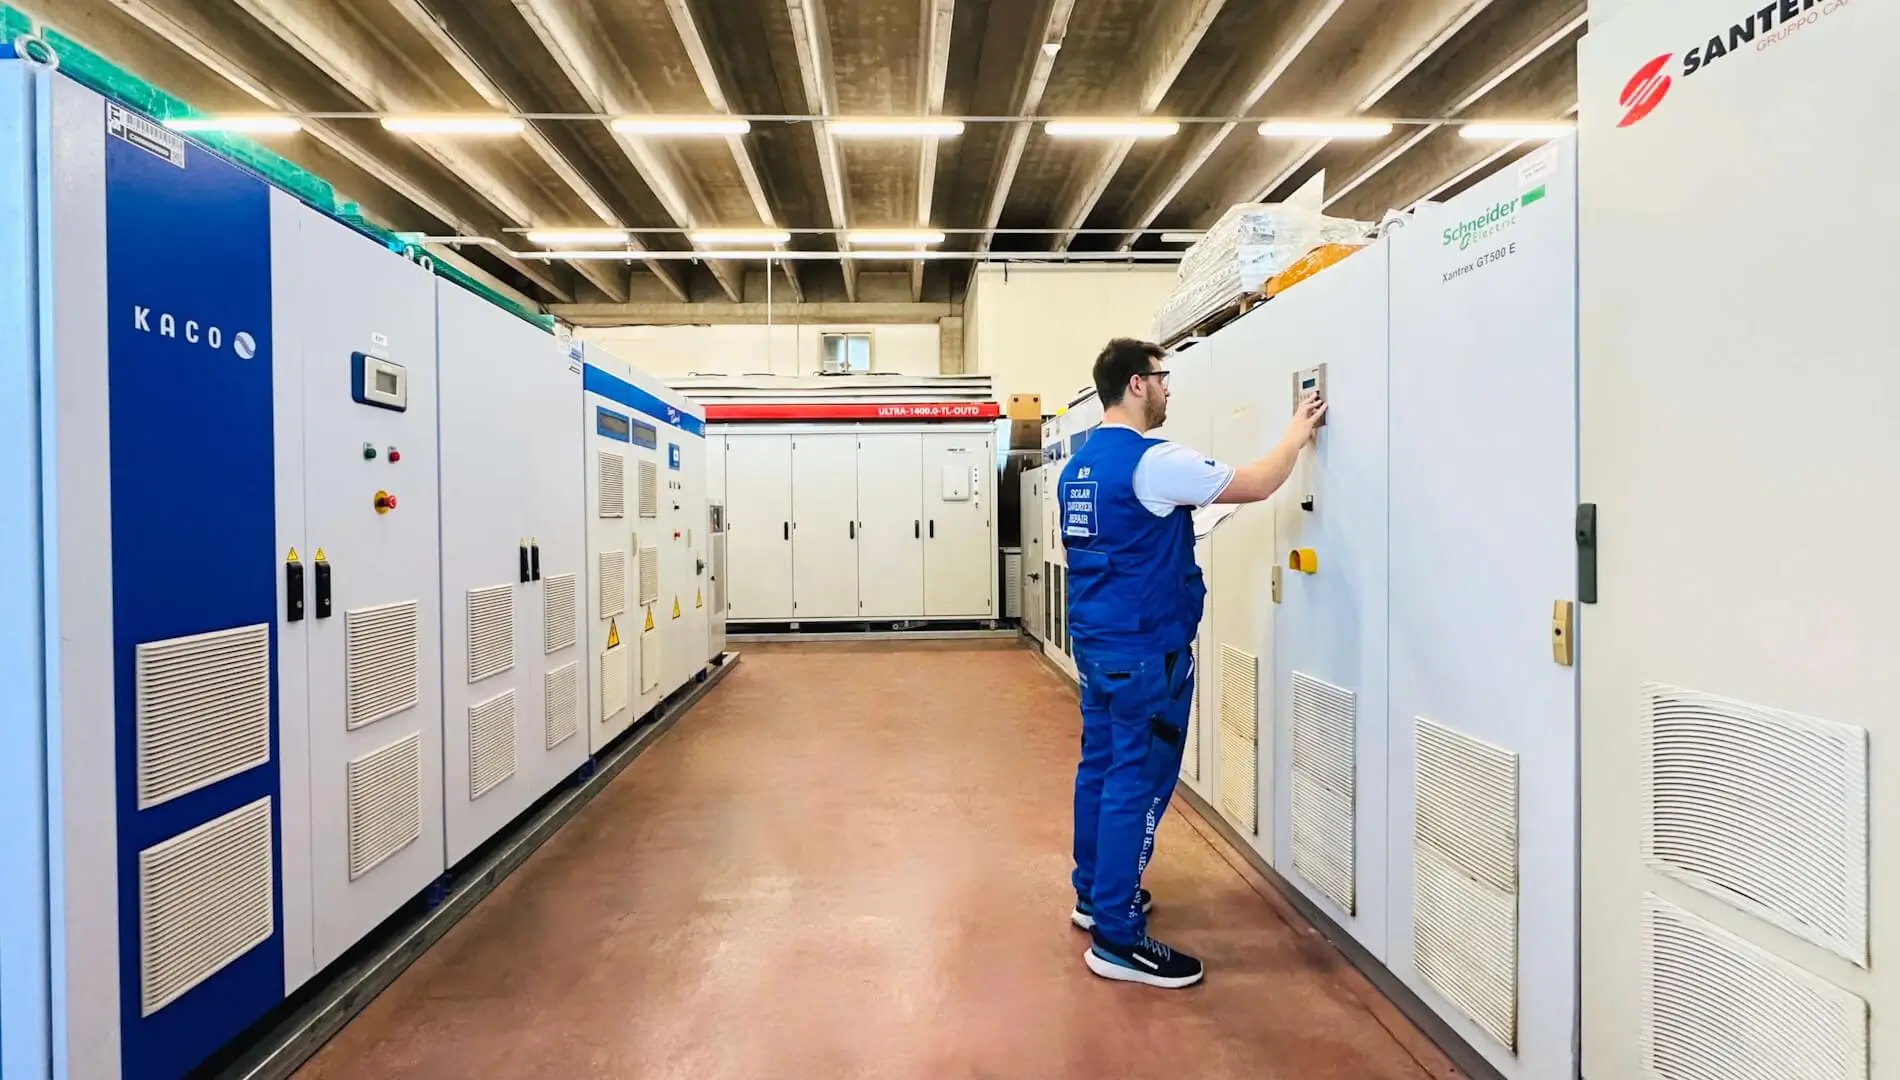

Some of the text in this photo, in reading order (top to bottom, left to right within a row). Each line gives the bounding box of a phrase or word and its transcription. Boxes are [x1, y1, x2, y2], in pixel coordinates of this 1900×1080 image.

[1755, 0, 1851, 52] GRUPPO CA
[1442, 196, 1519, 246] Schneider
[1472, 215, 1518, 244] Electric
[1441, 241, 1517, 285] Xantrex GT500 E
[134, 304, 222, 350] KACO
[878, 406, 980, 416] ULTRA-1400.0-TL-OUTD
